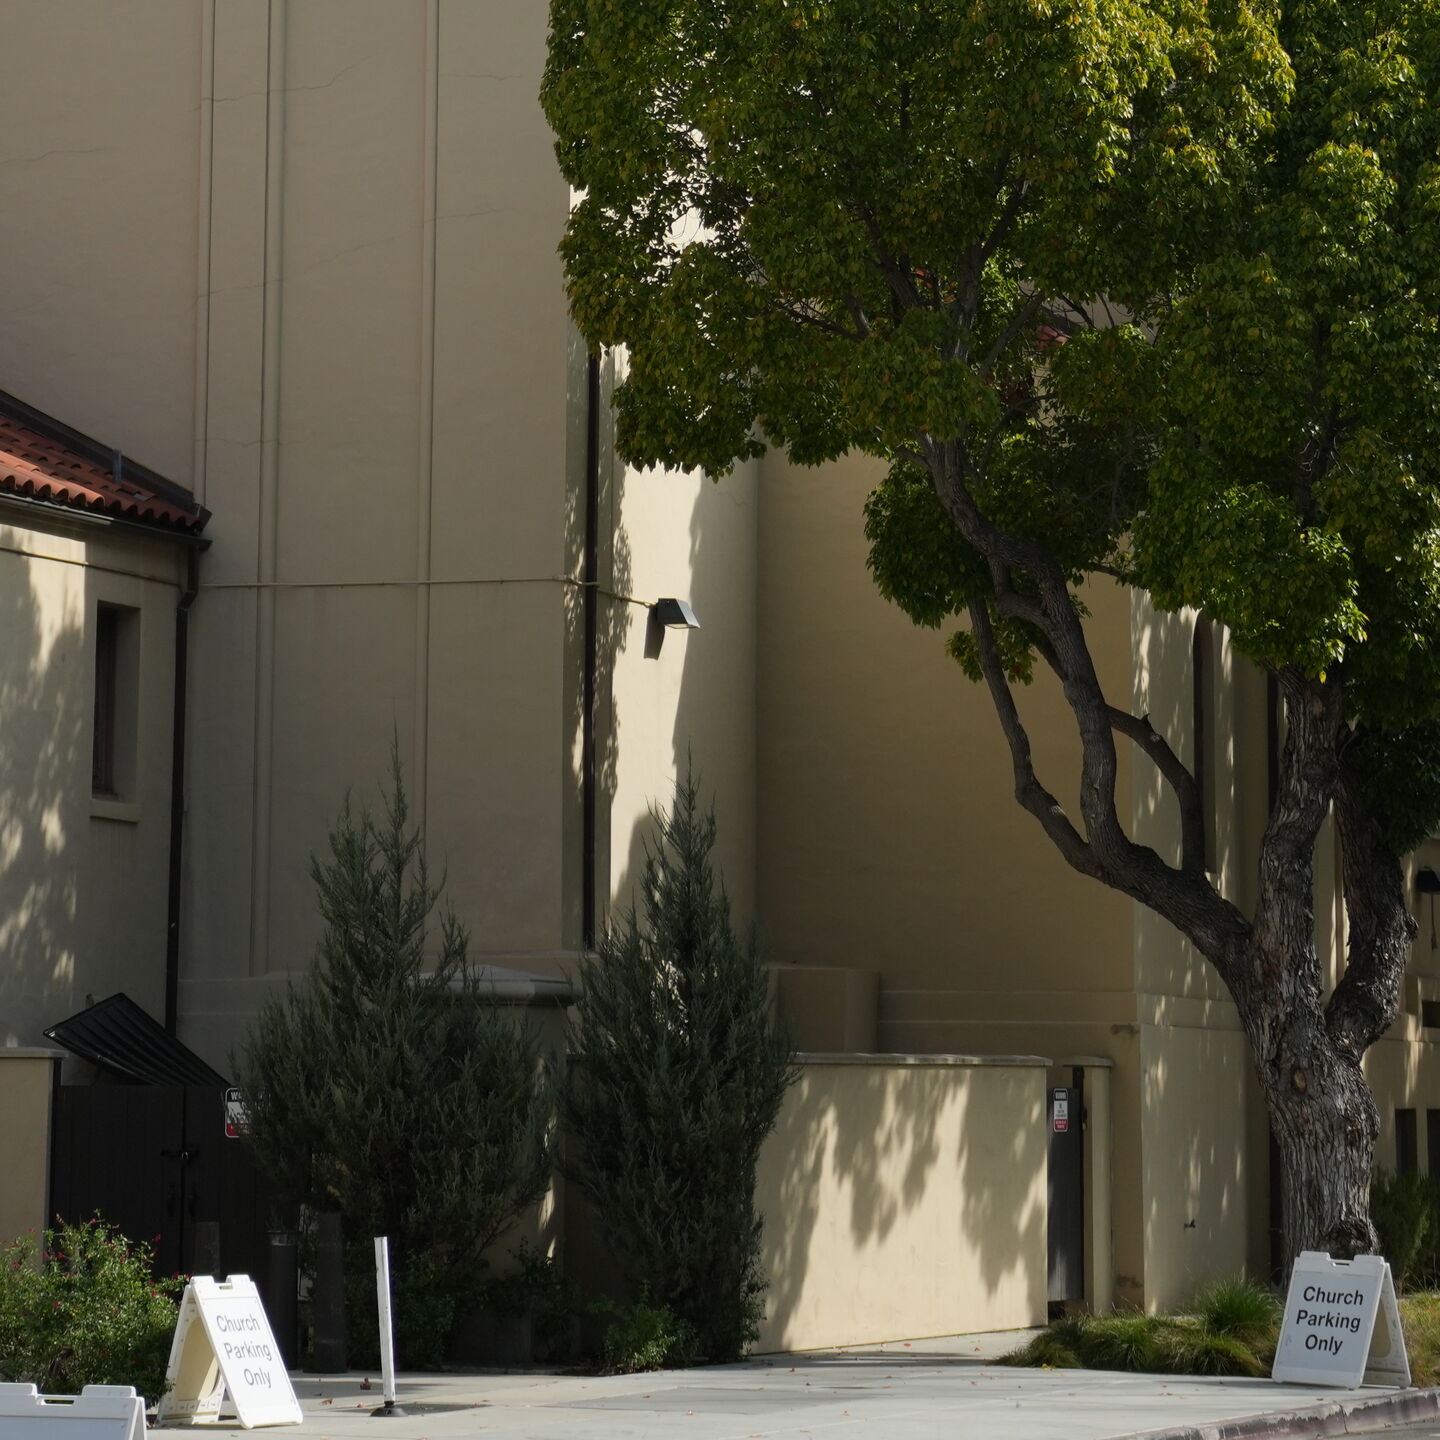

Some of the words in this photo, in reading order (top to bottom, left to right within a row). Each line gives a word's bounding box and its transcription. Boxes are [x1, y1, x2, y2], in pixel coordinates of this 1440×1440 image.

[1303, 1285, 1364, 1305] Church
[216, 1313, 260, 1333] Church
[1296, 1309, 1361, 1333] Parking
[224, 1340, 273, 1362] Parking
[1305, 1334, 1343, 1355] Only
[243, 1367, 272, 1390] Only
